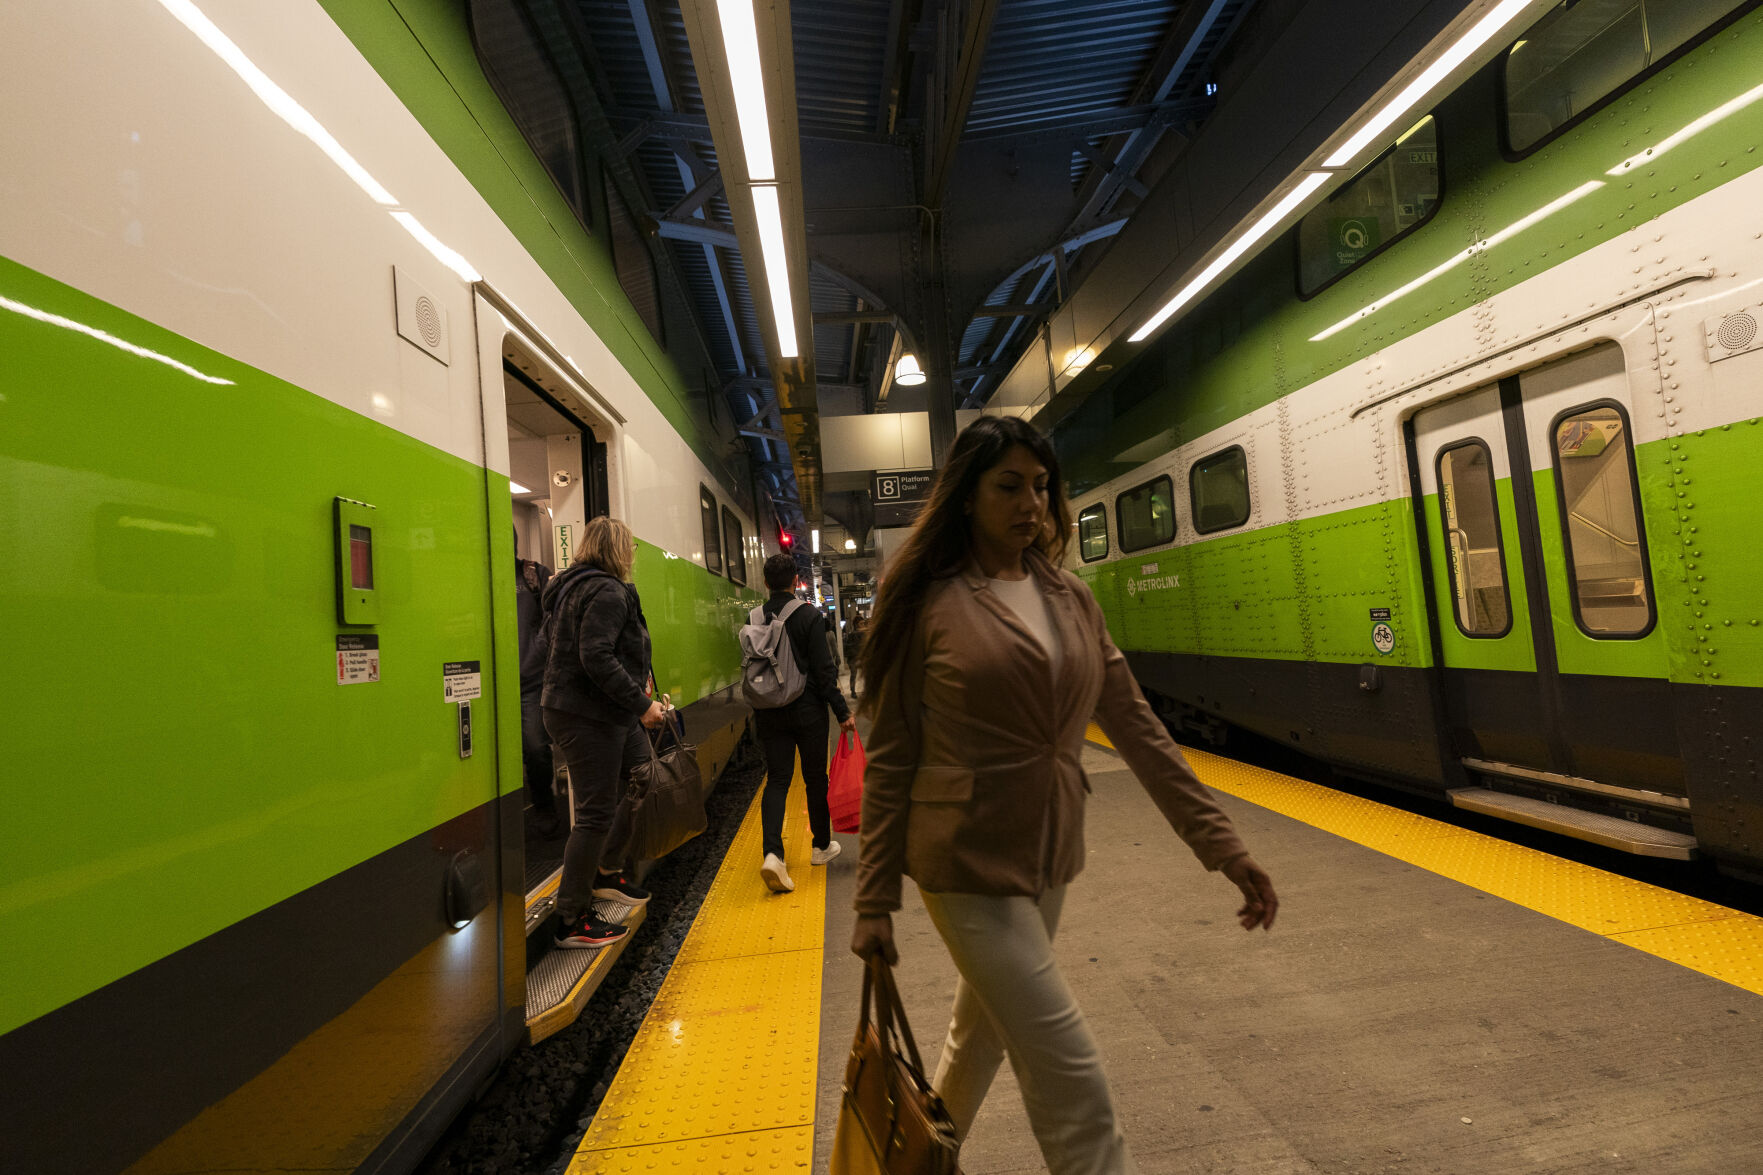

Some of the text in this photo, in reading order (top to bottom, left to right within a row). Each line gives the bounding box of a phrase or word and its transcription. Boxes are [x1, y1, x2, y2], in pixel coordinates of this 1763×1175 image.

[1411, 152, 1434, 162] EXIT
[883, 480, 894, 495] 8
[560, 526, 570, 568] EXIT
[1136, 575, 1180, 592] METROLINX
